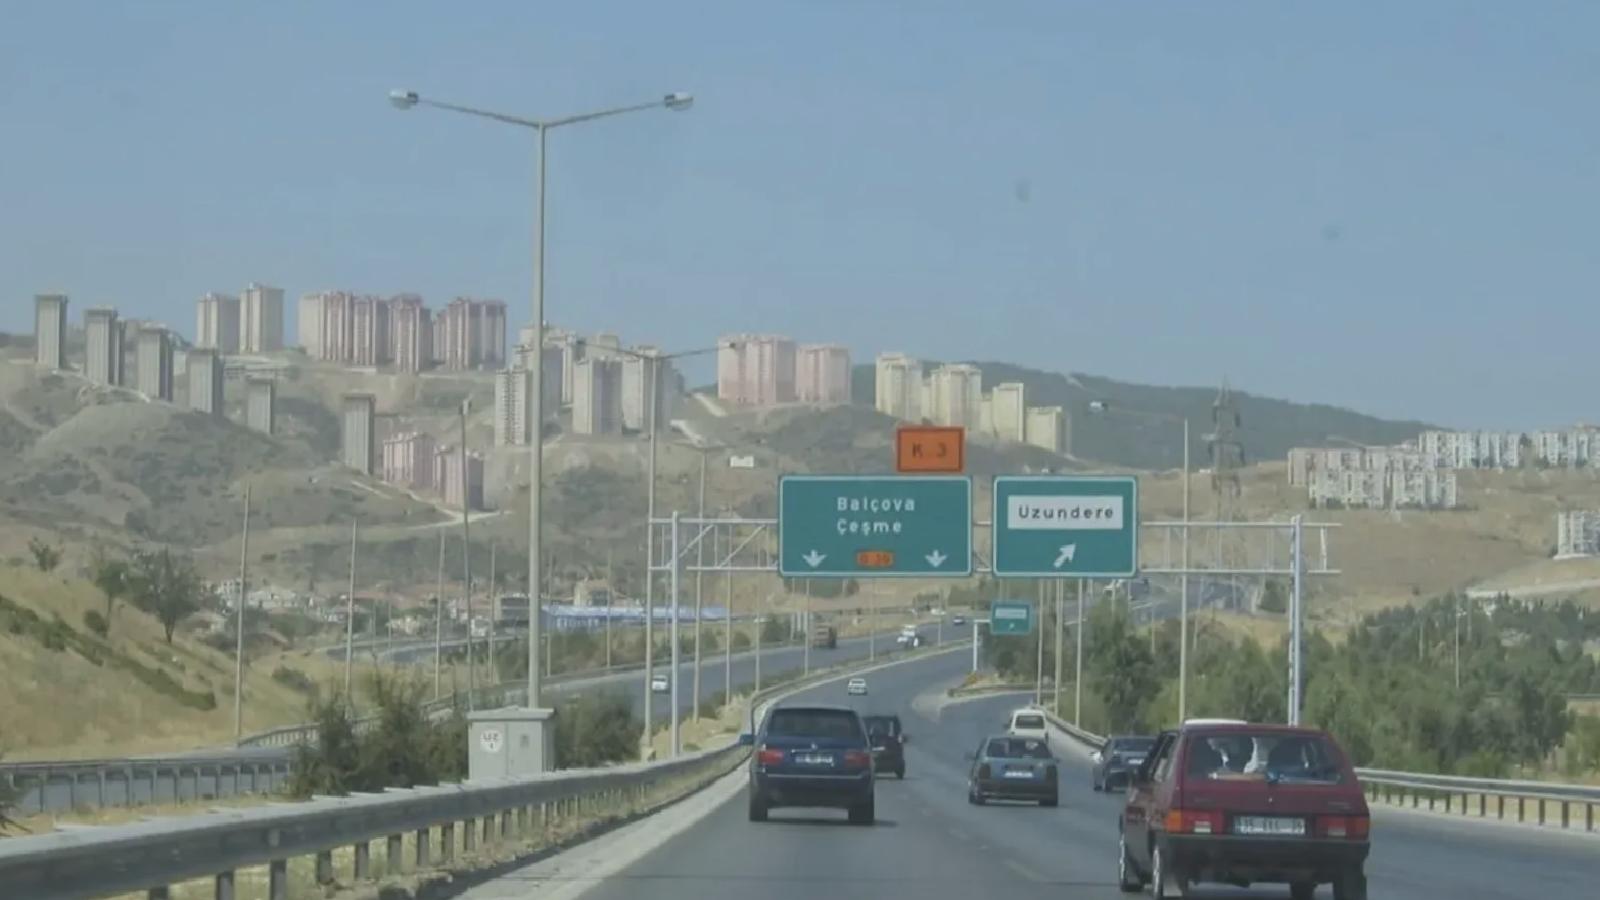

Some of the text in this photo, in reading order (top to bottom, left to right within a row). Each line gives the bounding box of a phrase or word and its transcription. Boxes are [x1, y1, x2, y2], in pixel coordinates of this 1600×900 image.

[836, 496, 915, 514] Balçova
[1018, 504, 1114, 519] Uzundere
[836, 517, 902, 536] Çeşme
